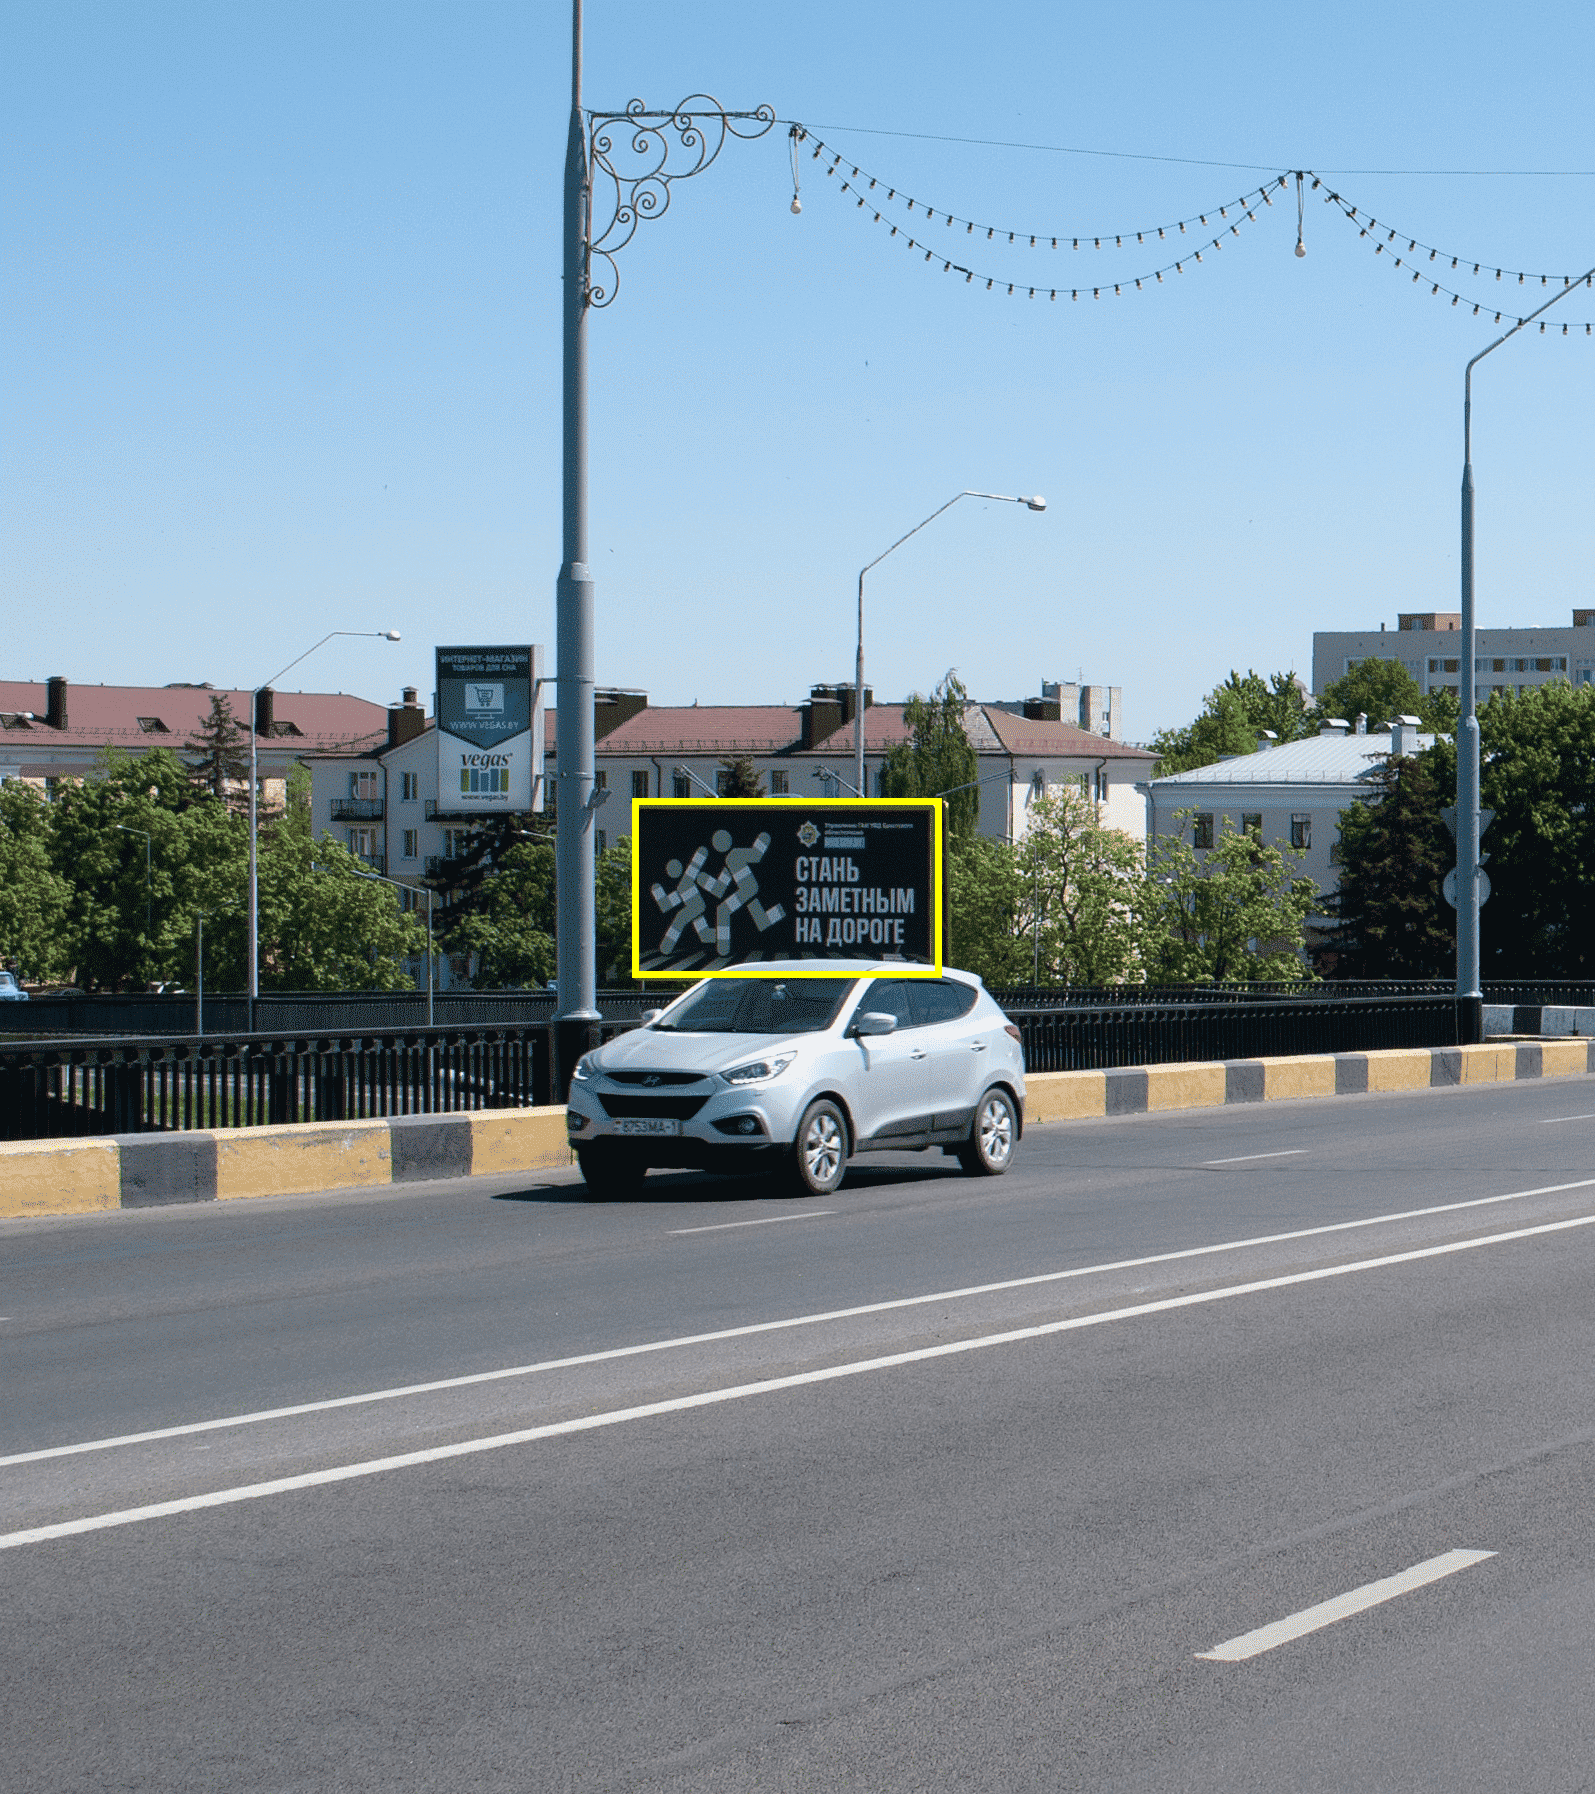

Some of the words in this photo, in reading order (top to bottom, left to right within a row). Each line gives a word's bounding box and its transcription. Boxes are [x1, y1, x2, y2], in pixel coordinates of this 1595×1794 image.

[440, 654, 529, 663] ИНТЕРНЕТ-МАГАЗИН
[460, 752, 510, 771] vegas
[795, 855, 860, 882] СТАНЬ
[795, 886, 915, 914] ЗАМЕТНЫМ
[795, 917, 822, 944] НА
[826, 918, 905, 947] ДОРОГЕ
